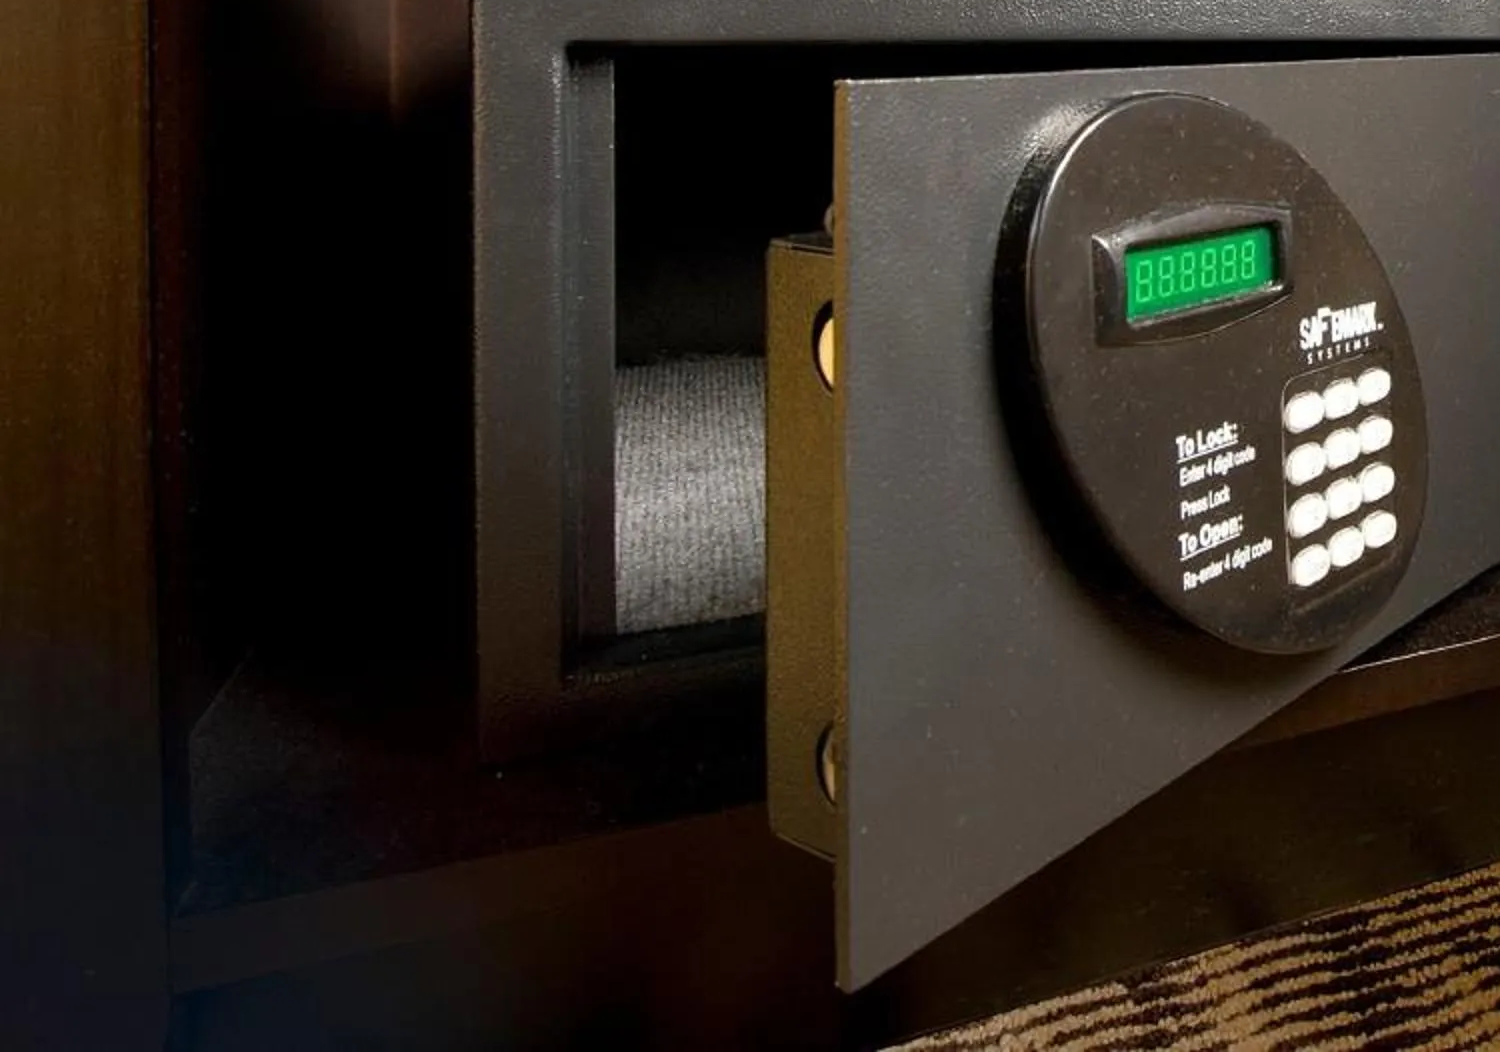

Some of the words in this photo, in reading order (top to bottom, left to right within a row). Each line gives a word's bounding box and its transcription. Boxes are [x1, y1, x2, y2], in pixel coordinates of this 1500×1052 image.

[1307, 336, 1370, 365] SYSTEMS
[1176, 435, 1195, 460] To
[1196, 421, 1238, 453] Lock:
[1180, 464, 1206, 487] Enter
[1213, 451, 1234, 476] digit
[1234, 445, 1256, 466] code
[1181, 495, 1208, 520] Press
[1208, 484, 1231, 509] Lock
[1178, 532, 1198, 558] To
[1199, 514, 1243, 548] Open:
[1231, 544, 1251, 569] digit
[1251, 535, 1273, 559] code
